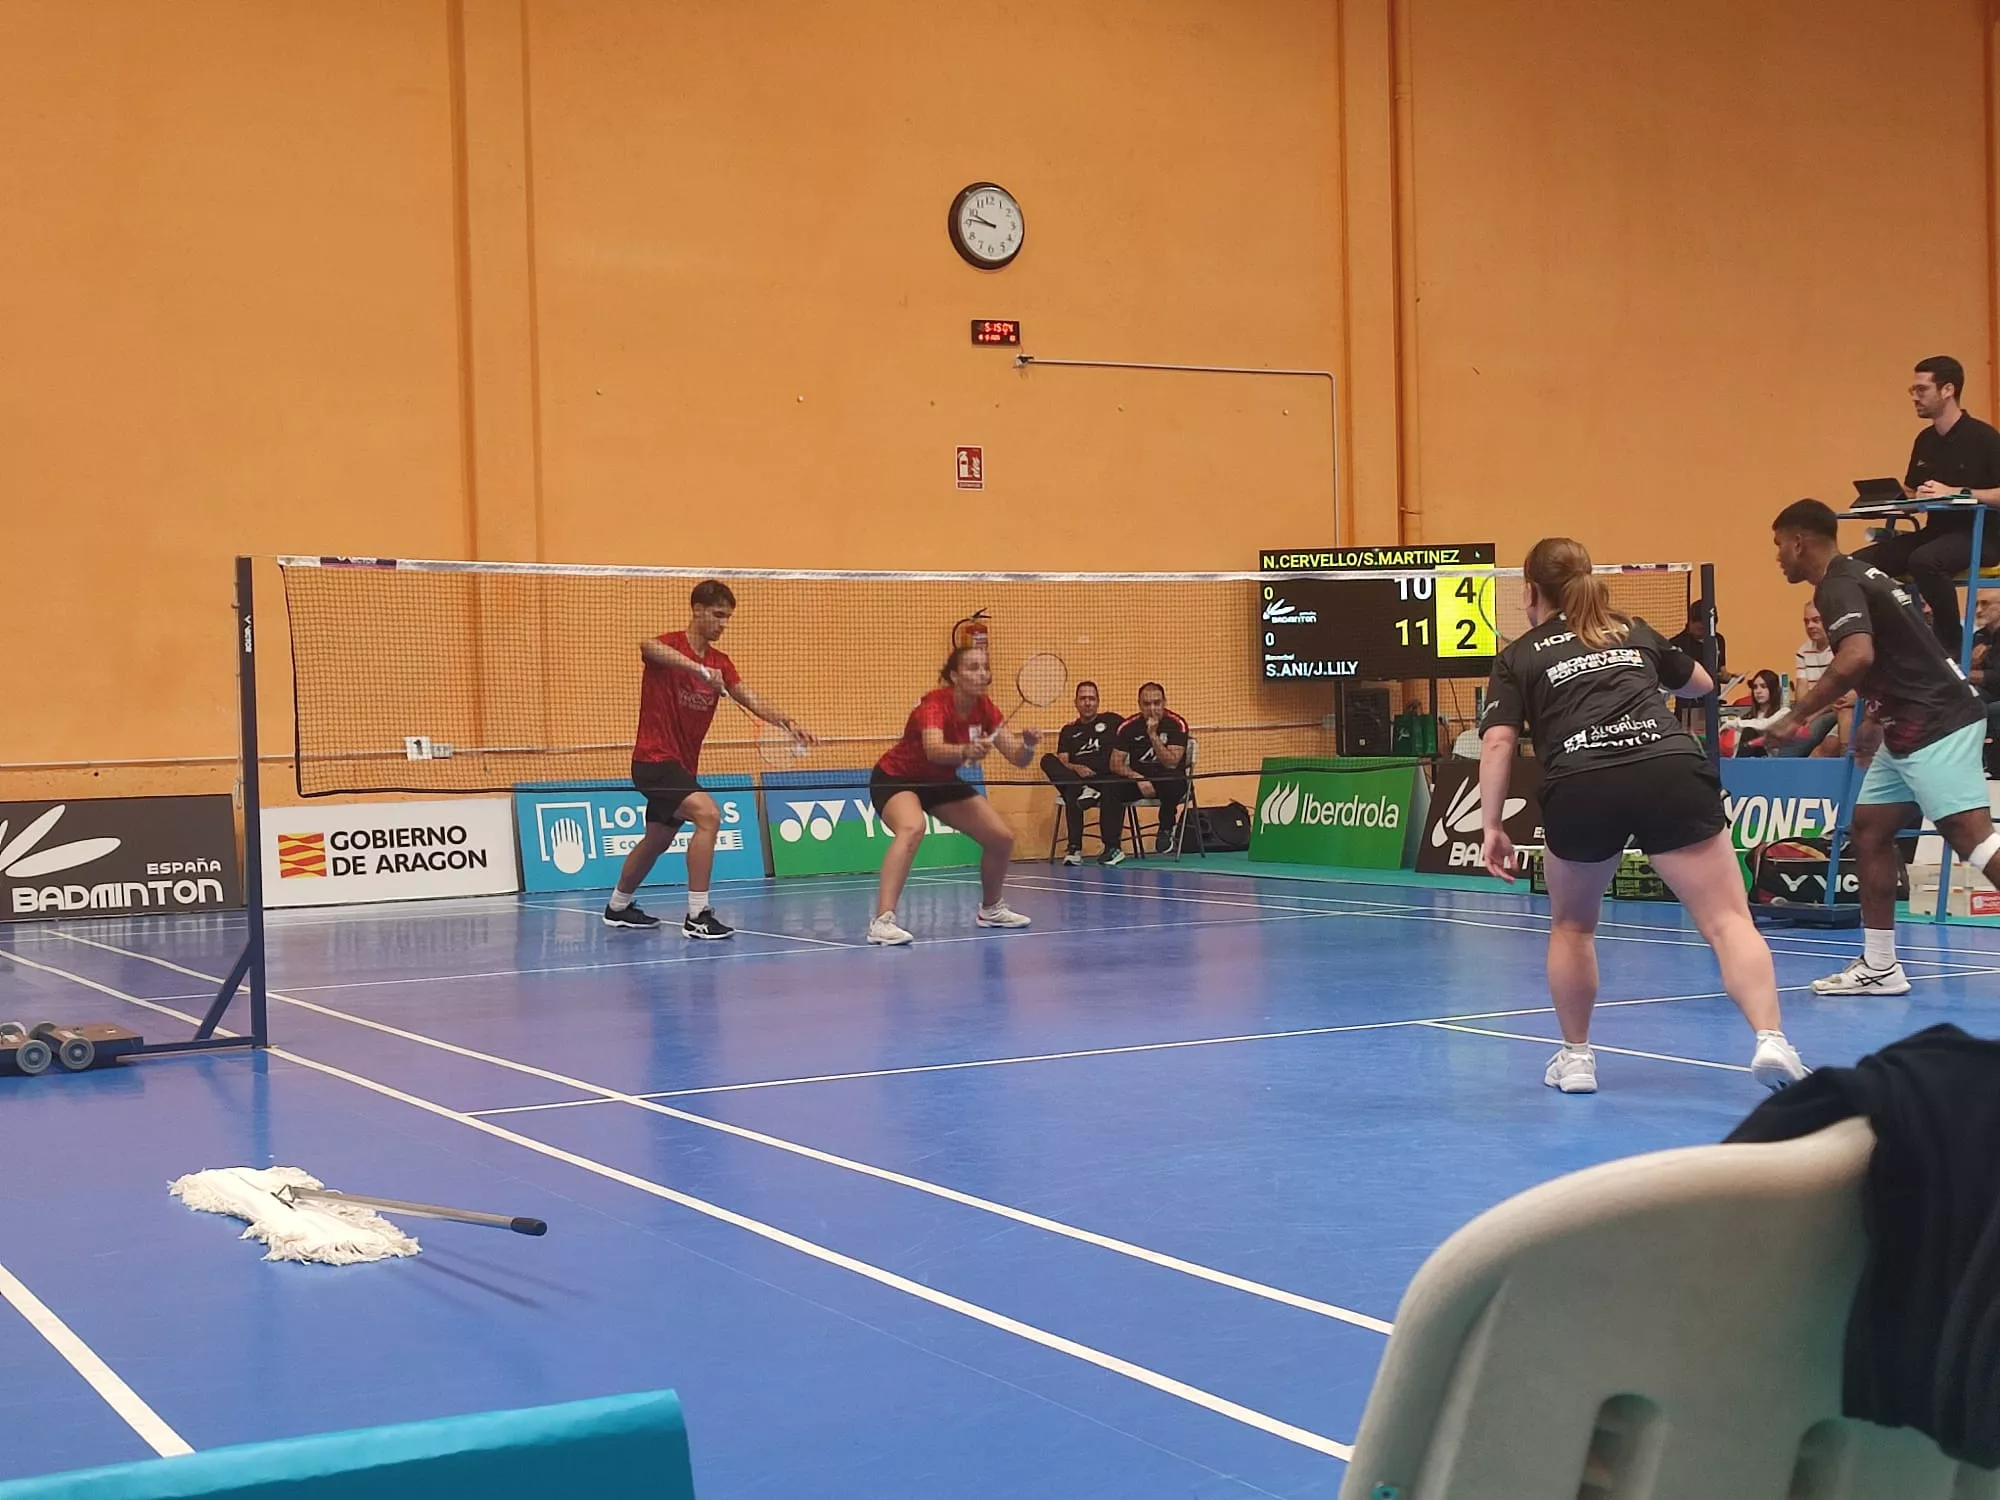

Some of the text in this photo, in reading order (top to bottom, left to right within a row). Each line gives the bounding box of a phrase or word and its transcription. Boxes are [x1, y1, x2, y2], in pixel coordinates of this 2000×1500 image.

[975, 197, 984, 208] 11
[985, 195, 996, 206] 12
[969, 208, 979, 217] 10
[1005, 208, 1012, 218] 2
[1010, 221, 1017, 231] 3
[968, 231, 976, 241] 8
[1007, 233, 1014, 243] 4
[977, 240, 984, 250] 7
[987, 244, 995, 257] 6
[1000, 241, 1006, 253] 5
[1263, 550, 1460, 569] N.CERVELLO/S.MARTINEZ
[1264, 586, 1274, 600] 0
[1394, 577, 1433, 600] 10
[1455, 576, 1476, 604] 4
[1265, 631, 1275, 646] 0
[1395, 618, 1429, 646] 11
[1455, 619, 1478, 649] 2
[1266, 661, 1359, 677] S.ANI/J.LILY
[413, 739, 423, 756] 1
[1301, 792, 1399, 829] Iberdrola
[330, 825, 467, 851] GOBIERNO
[146, 858, 222, 875] ESPAÑA
[332, 849, 487, 876] DE ARAGON
[12, 878, 224, 913] BADMINTON
